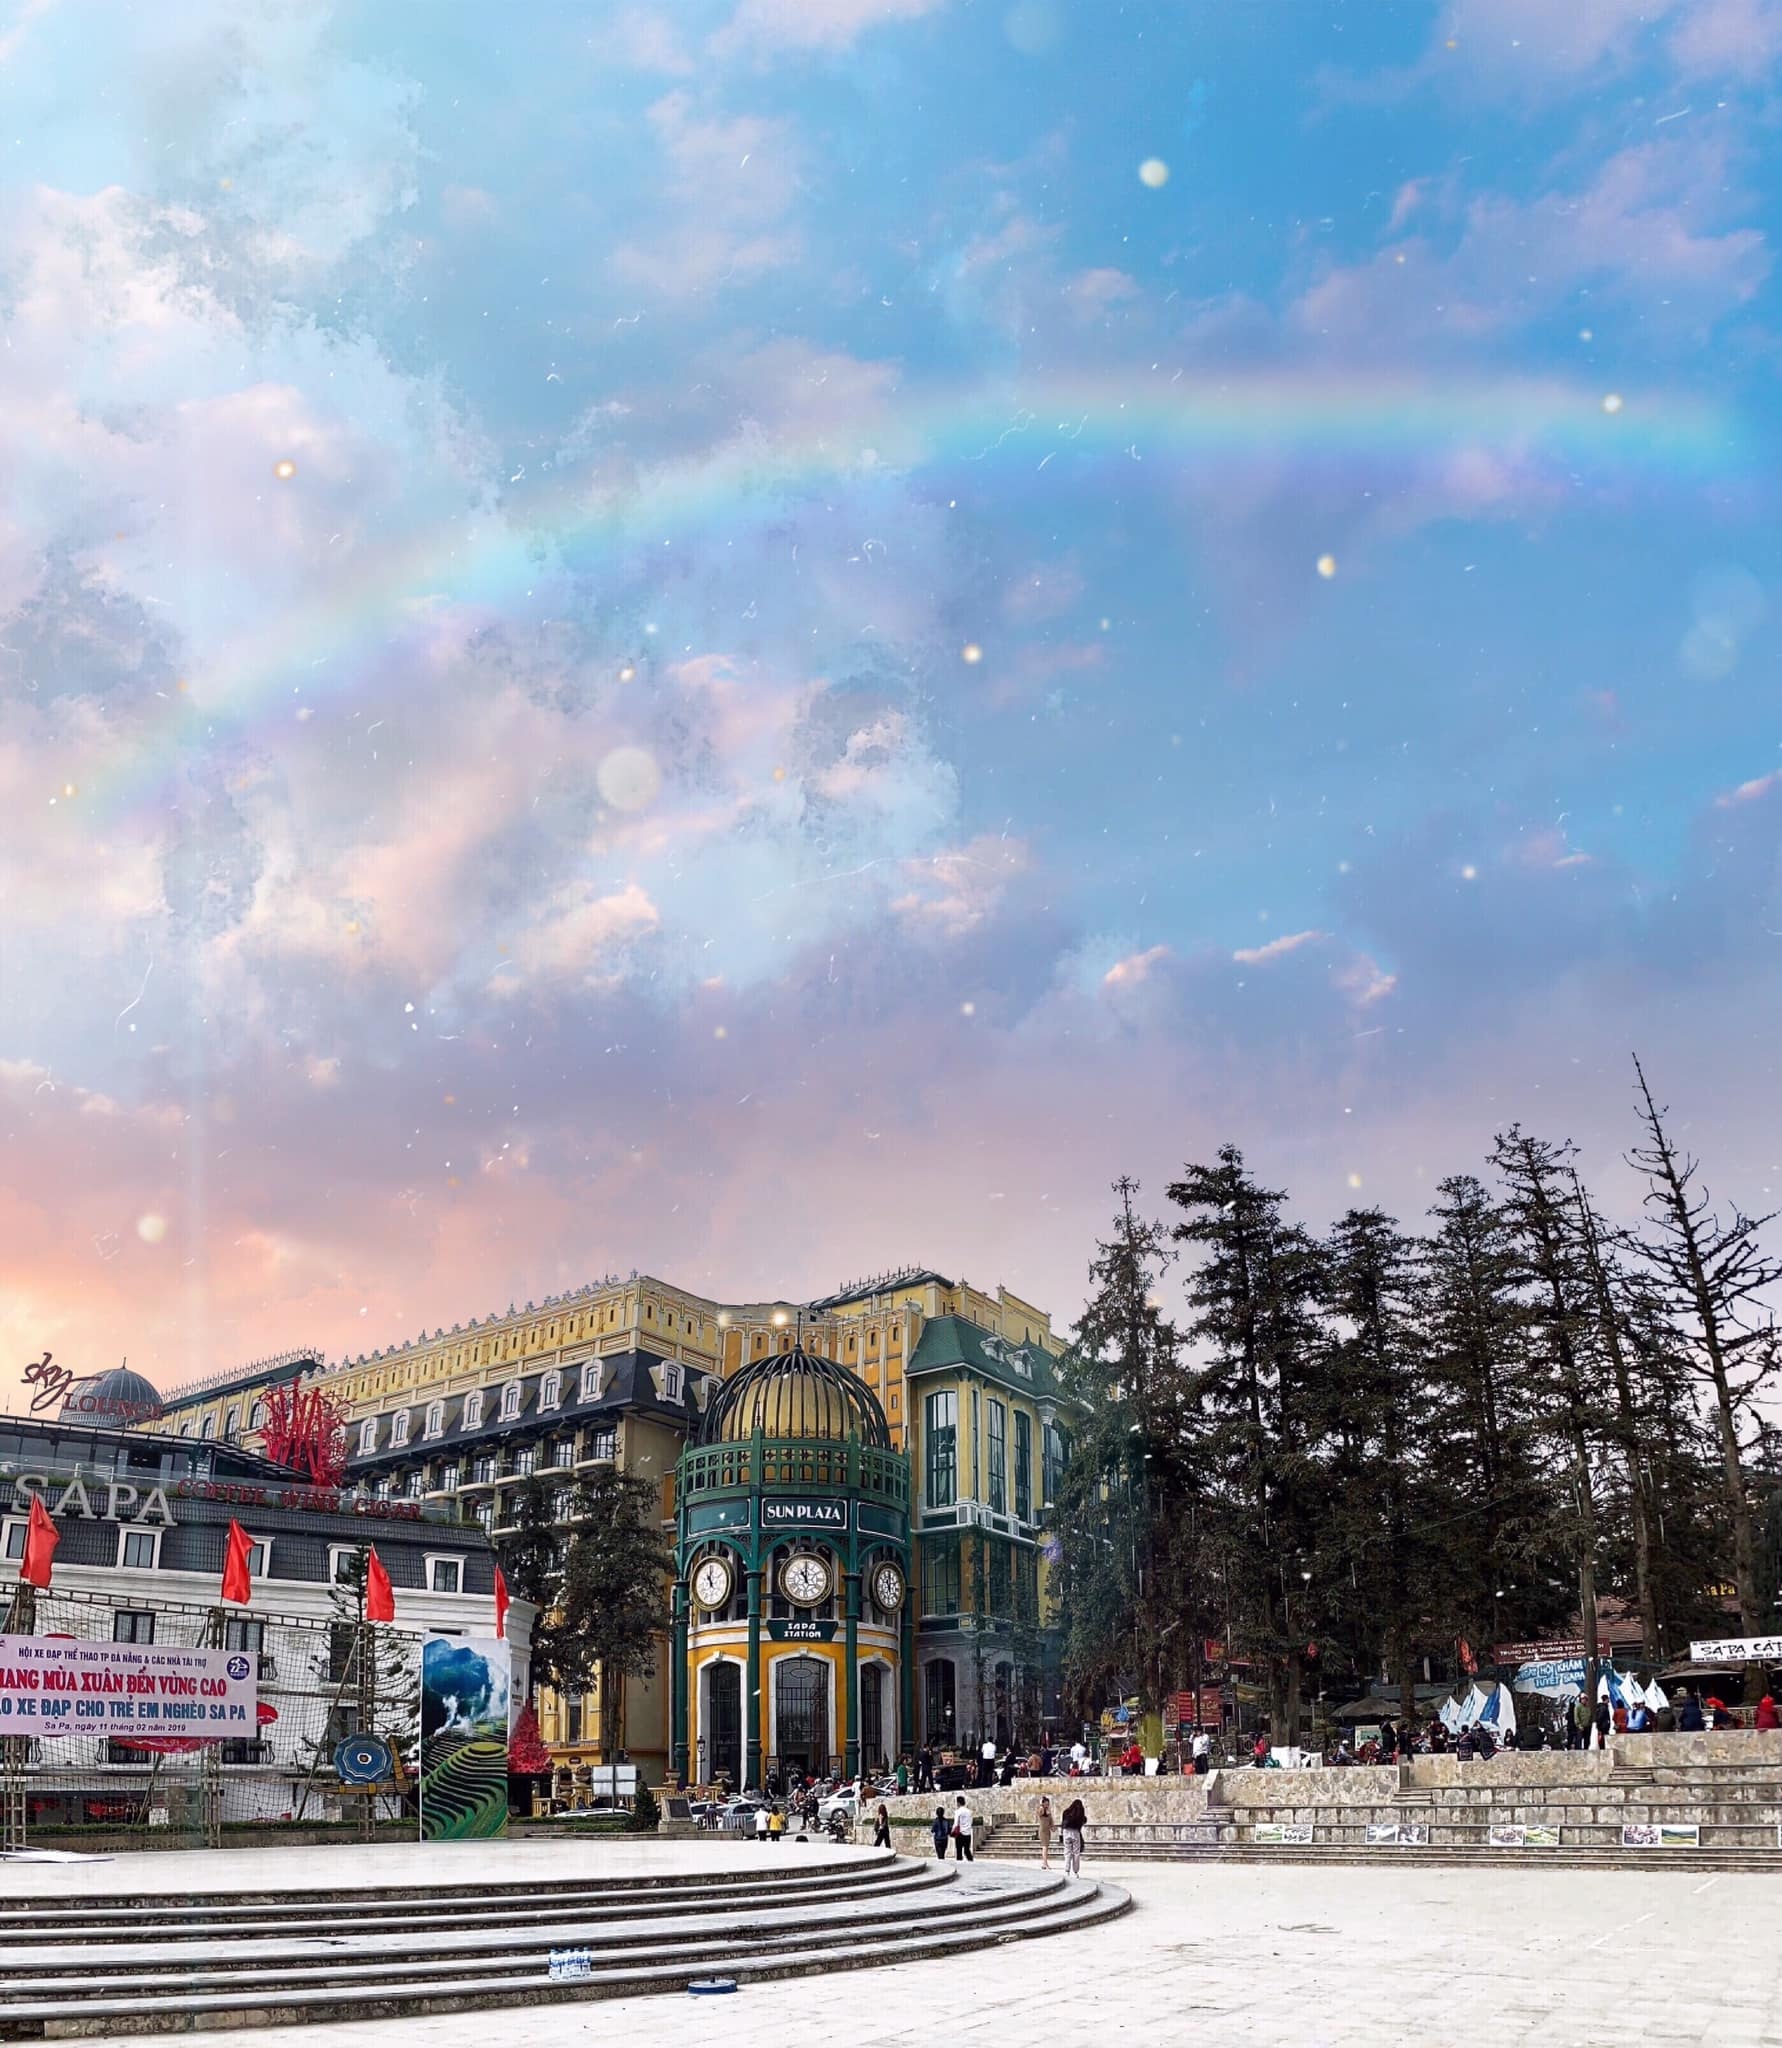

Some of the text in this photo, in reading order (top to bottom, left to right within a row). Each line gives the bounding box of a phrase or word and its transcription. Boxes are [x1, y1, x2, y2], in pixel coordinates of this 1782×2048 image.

[63, 1393, 164, 1421] LOUNGE
[11, 1474, 178, 1526] SAPA
[177, 1478, 420, 1520] COFFEE WINE CIGAR
[767, 1505, 841, 1520] SUN PLAZA
[784, 1630, 821, 1638] STATION
[19, 1646, 32, 1658] HỘI
[34, 1649, 44, 1658] XE
[46, 1649, 62, 1661] ĐẠP
[80, 1651, 98, 1661] THAO
[100, 1653, 109, 1662] TP
[144, 1656, 149, 1664] &
[151, 1654, 166, 1665] CÁC
[167, 1656, 181, 1666] NHÀ
[43, 1665, 77, 1691] MÙA
[81, 1667, 123, 1692] XUÂN
[126, 1666, 156, 1694] ĐẾN
[159, 1671, 197, 1695] VÙNG
[200, 1678, 227, 1696] CAO
[17, 1699, 36, 1715] XE
[41, 1699, 71, 1720] ĐẠP
[76, 1699, 105, 1717] CHO
[109, 1695, 134, 1717] TRẺ
[138, 1702, 159, 1718] EM
[163, 1700, 206, 1719] NGHÈO
[210, 1704, 226, 1720] SA
[230, 1705, 246, 1720] PA
[44, 1722, 56, 1730] Sa
[59, 1722, 72, 1731] Pa,
[110, 1722, 134, 1732] tháng
[136, 1723, 146, 1731] 02
[168, 1724, 186, 1732] 2019
